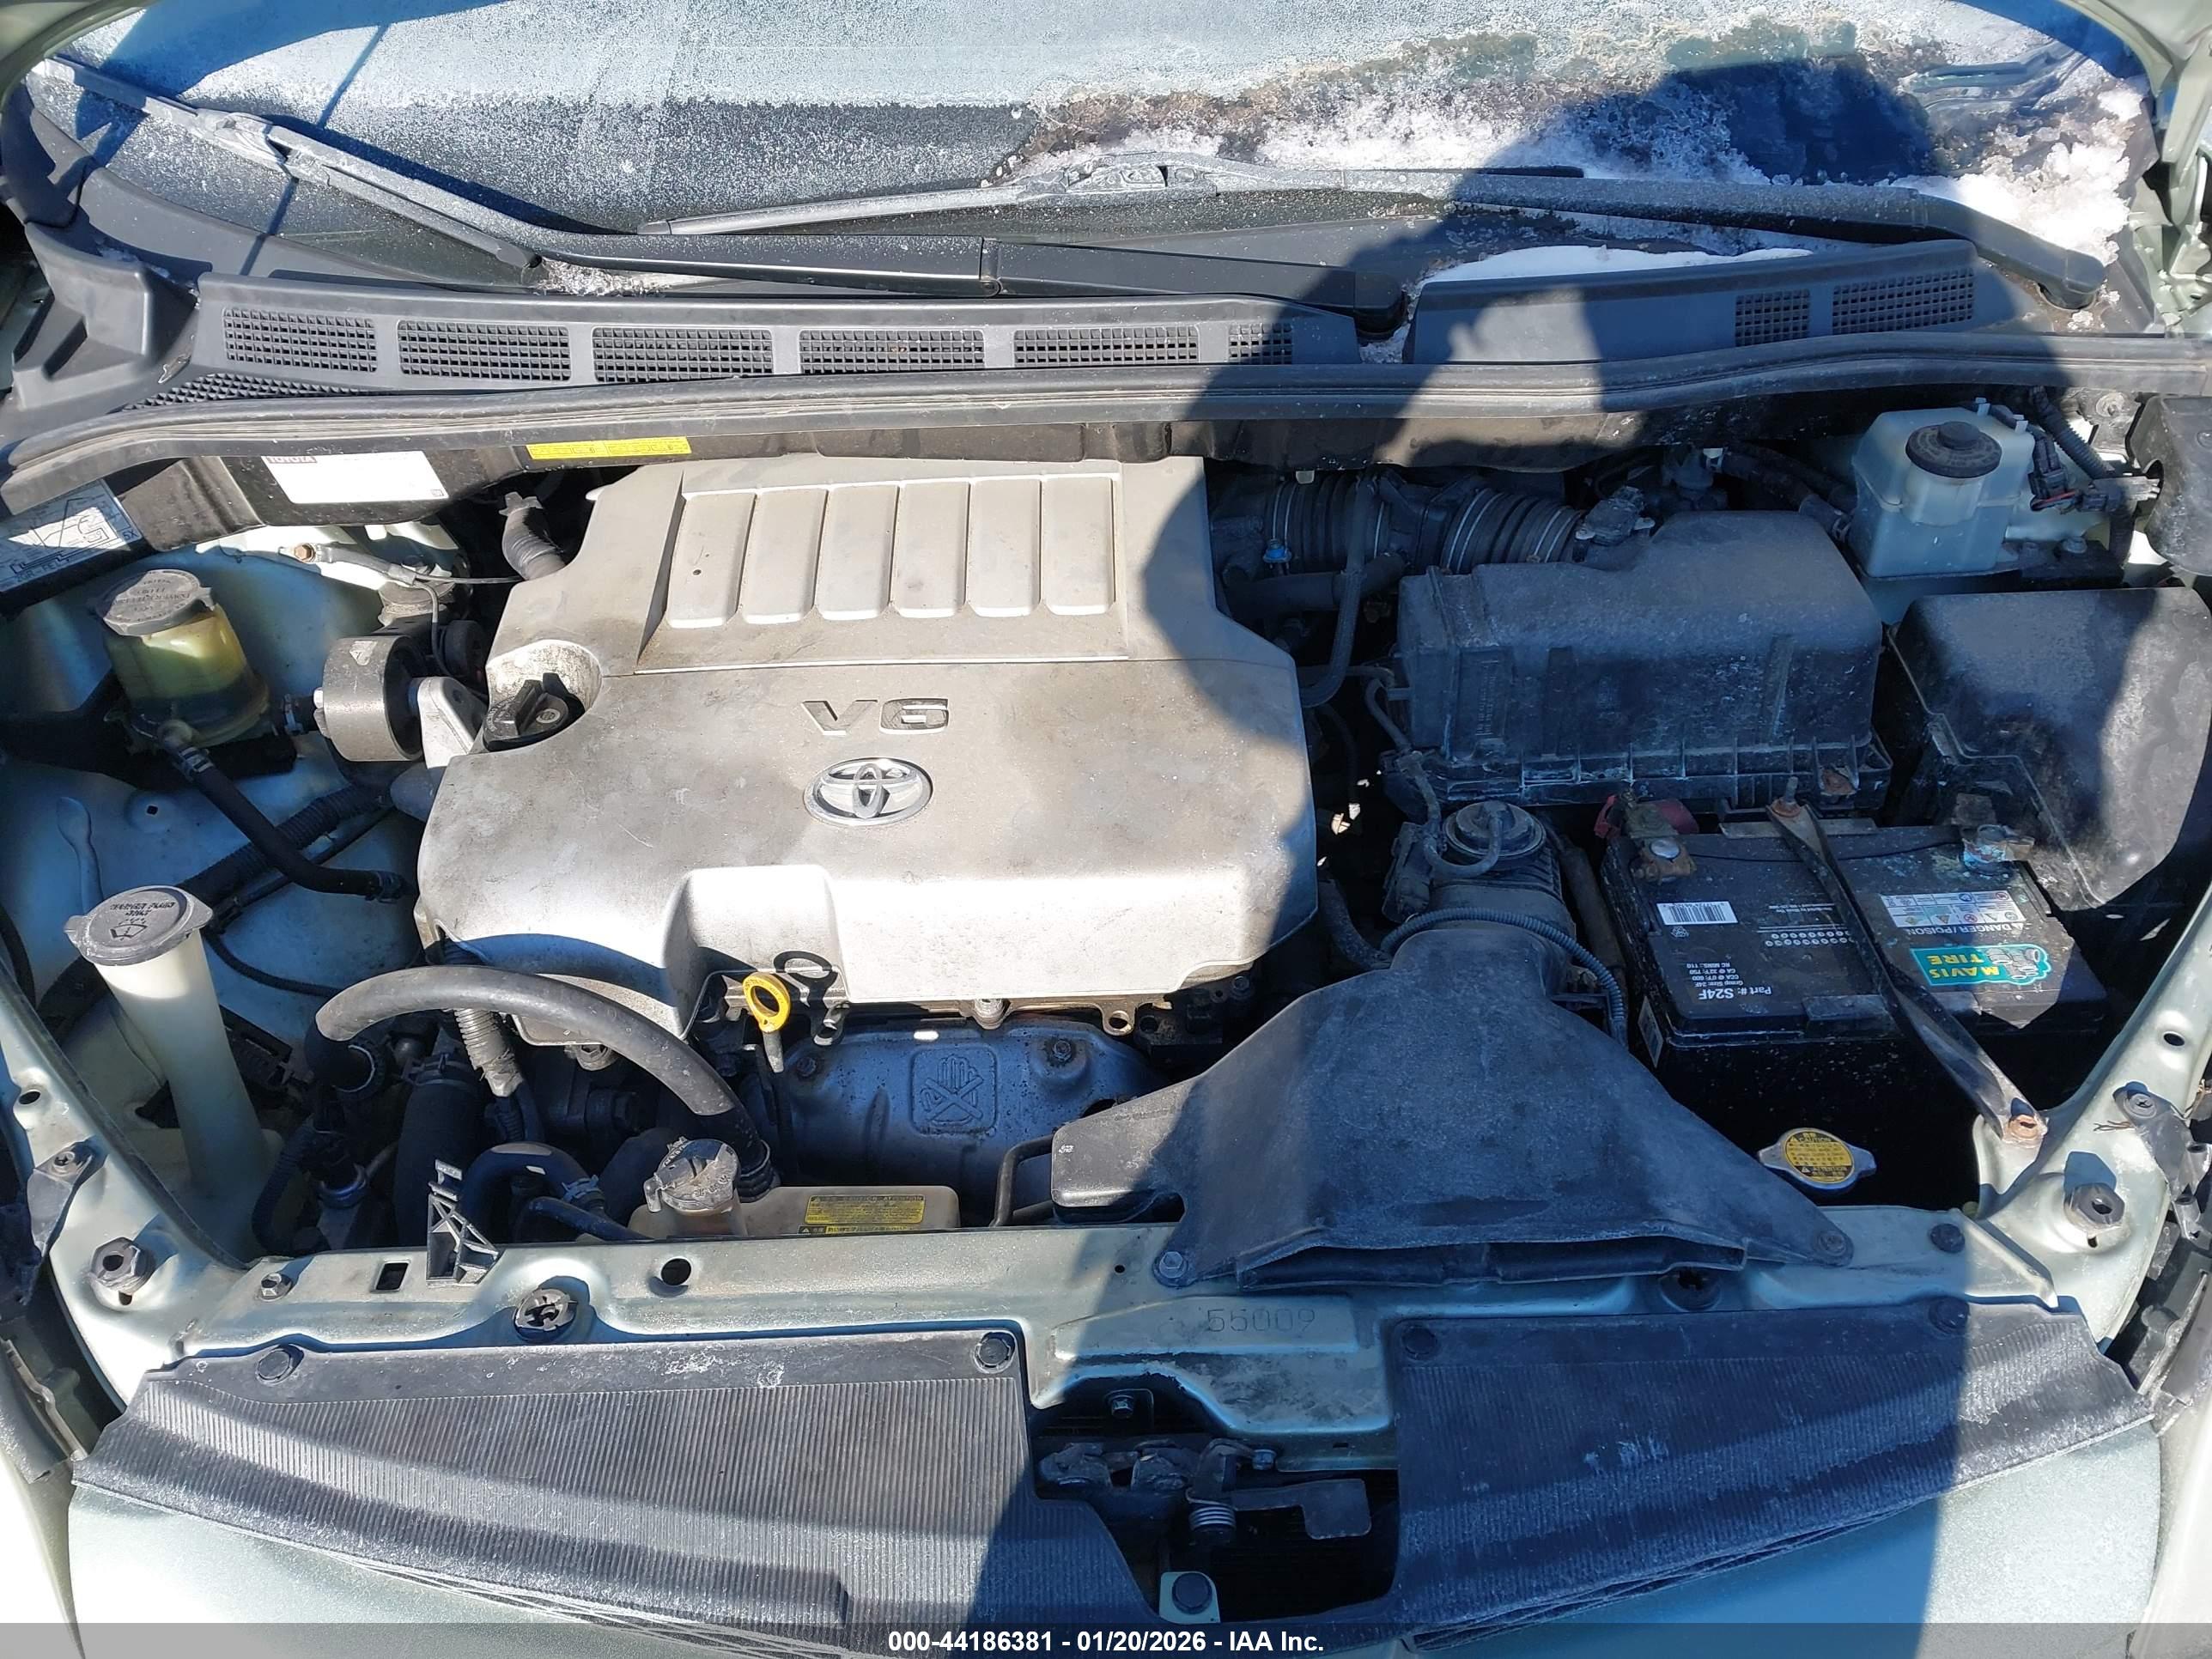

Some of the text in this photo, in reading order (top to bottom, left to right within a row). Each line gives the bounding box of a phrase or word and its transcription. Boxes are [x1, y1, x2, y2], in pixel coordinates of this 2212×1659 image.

[801, 697, 950, 736] V6
[1905, 927, 1952, 936] POISON
[1960, 923, 2013, 934] DANGER
[1925, 953, 1985, 966] TIRE
[1929, 965, 2000, 979] MAVIS
[1698, 988, 1735, 1000] S24F
[1749, 986, 1773, 995] Part
[1206, 1308, 1316, 1333] 55009
